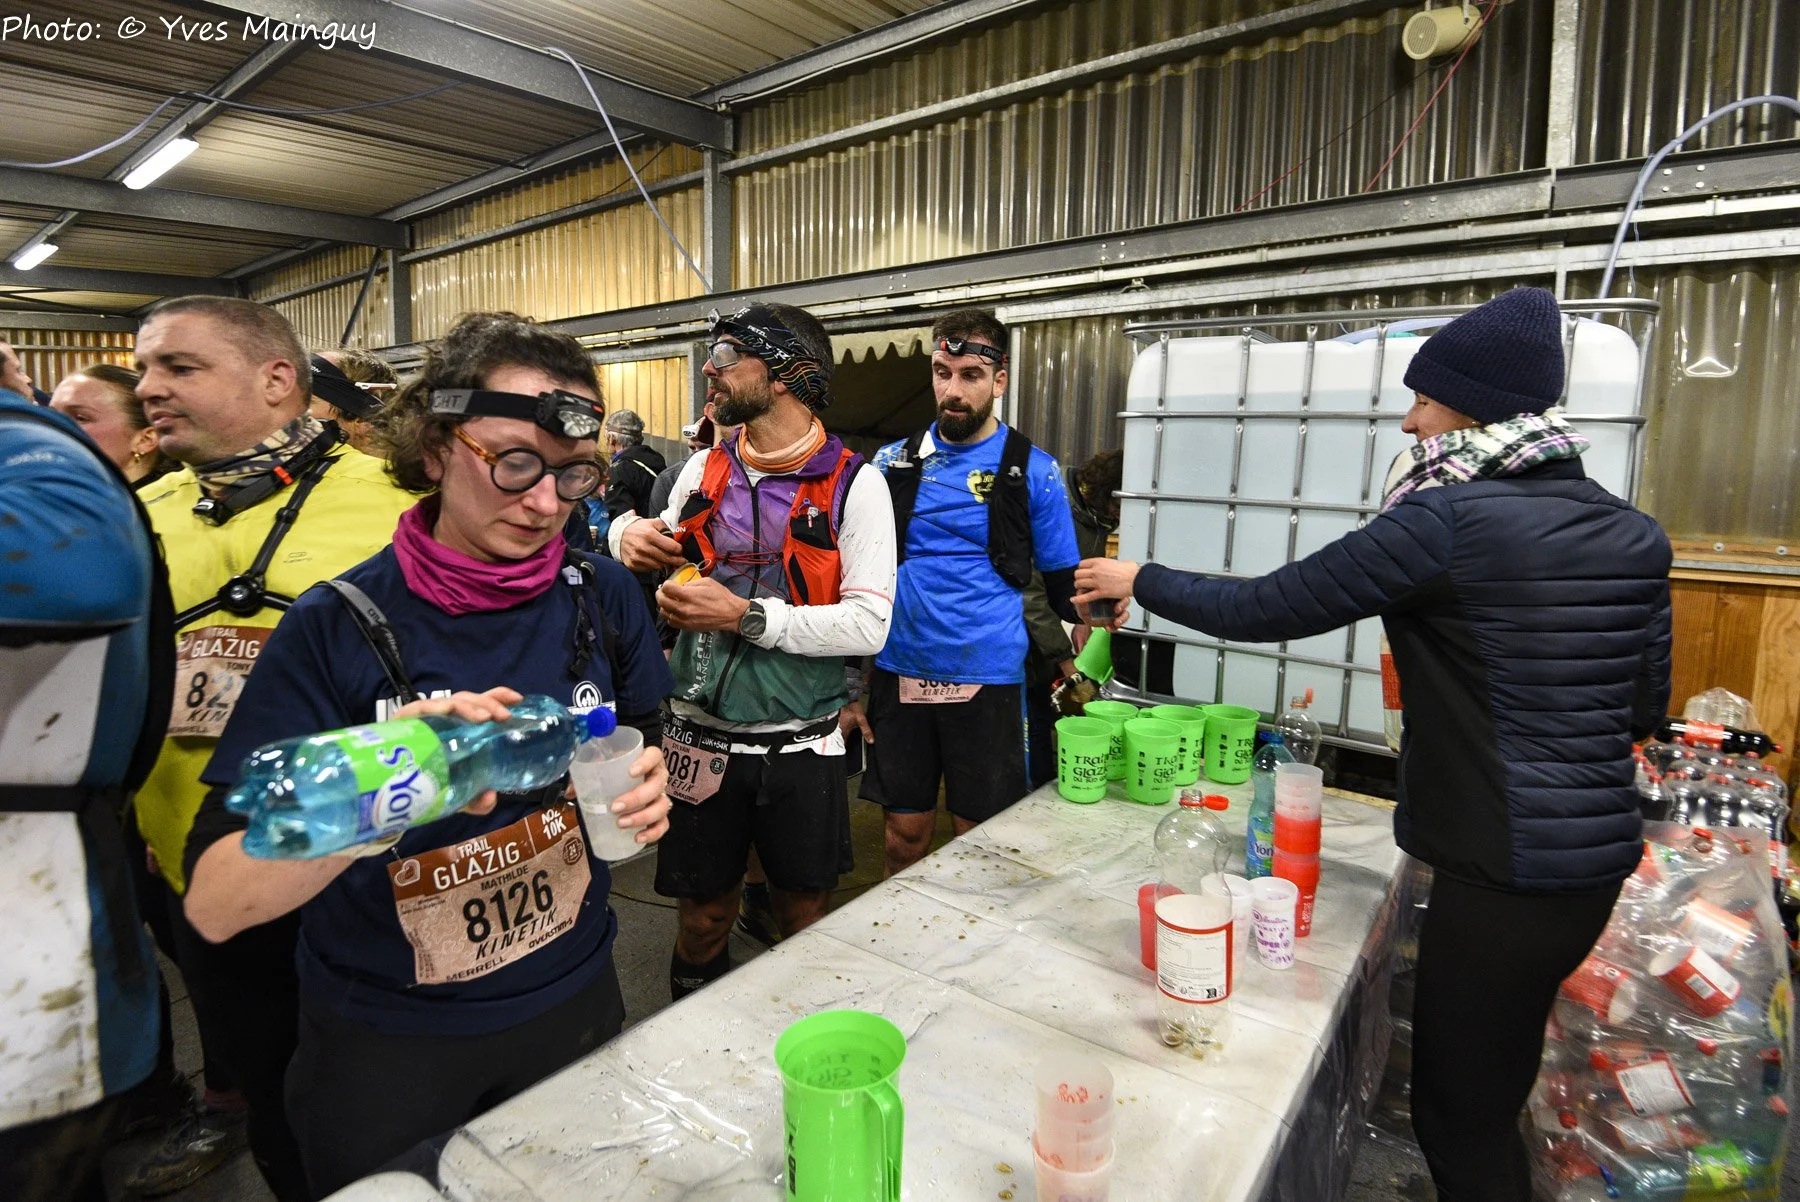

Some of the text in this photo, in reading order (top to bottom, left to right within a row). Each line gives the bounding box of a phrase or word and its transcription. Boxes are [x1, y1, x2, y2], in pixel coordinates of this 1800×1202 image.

[211, 627, 239, 638] TRAIL
[190, 638, 261, 659] GLAZIG
[225, 661, 251, 672] TONY
[186, 671, 249, 709] 82
[543, 816, 567, 840] 10K
[456, 838, 492, 859] TRAIL
[432, 841, 521, 891] GLAZIG
[480, 864, 530, 892] MATHILDE
[462, 869, 554, 943] 8126
[475, 907, 558, 960] KINETIK
[446, 956, 508, 982] MERRELL
